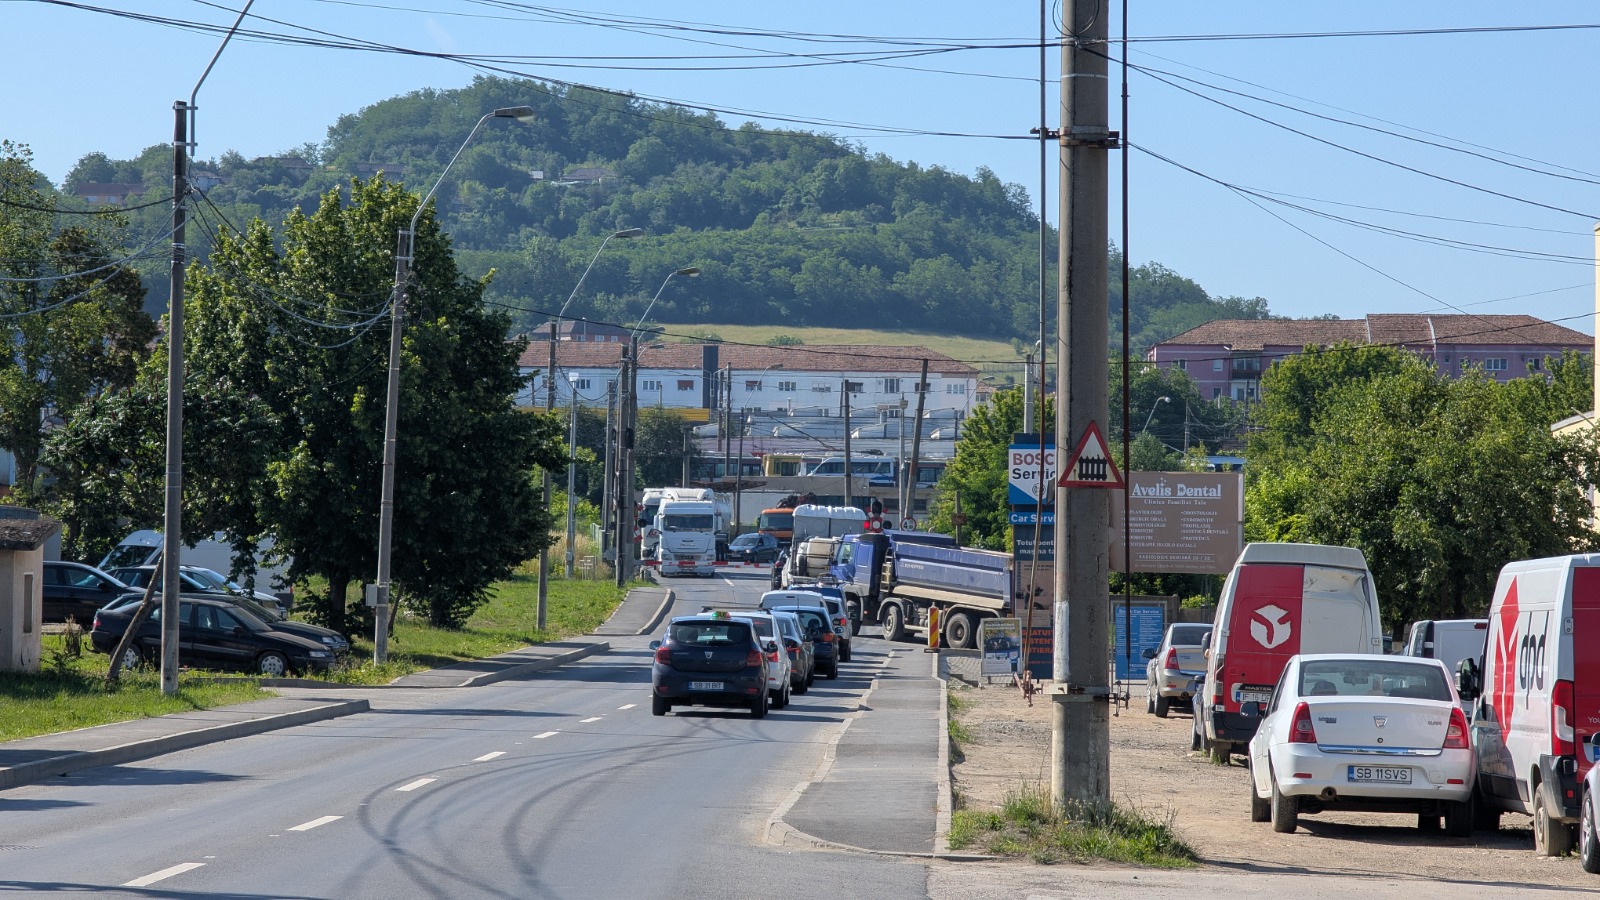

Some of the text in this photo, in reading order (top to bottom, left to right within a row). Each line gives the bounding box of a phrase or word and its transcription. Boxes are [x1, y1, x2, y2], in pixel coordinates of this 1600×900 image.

[1012, 452, 1055, 466] BOSC
[1132, 483, 1222, 497] Avelis Dental
[1010, 513, 1028, 523] Car
[1519, 611, 1549, 710] dpd
[1356, 768, 1372, 778] SB
